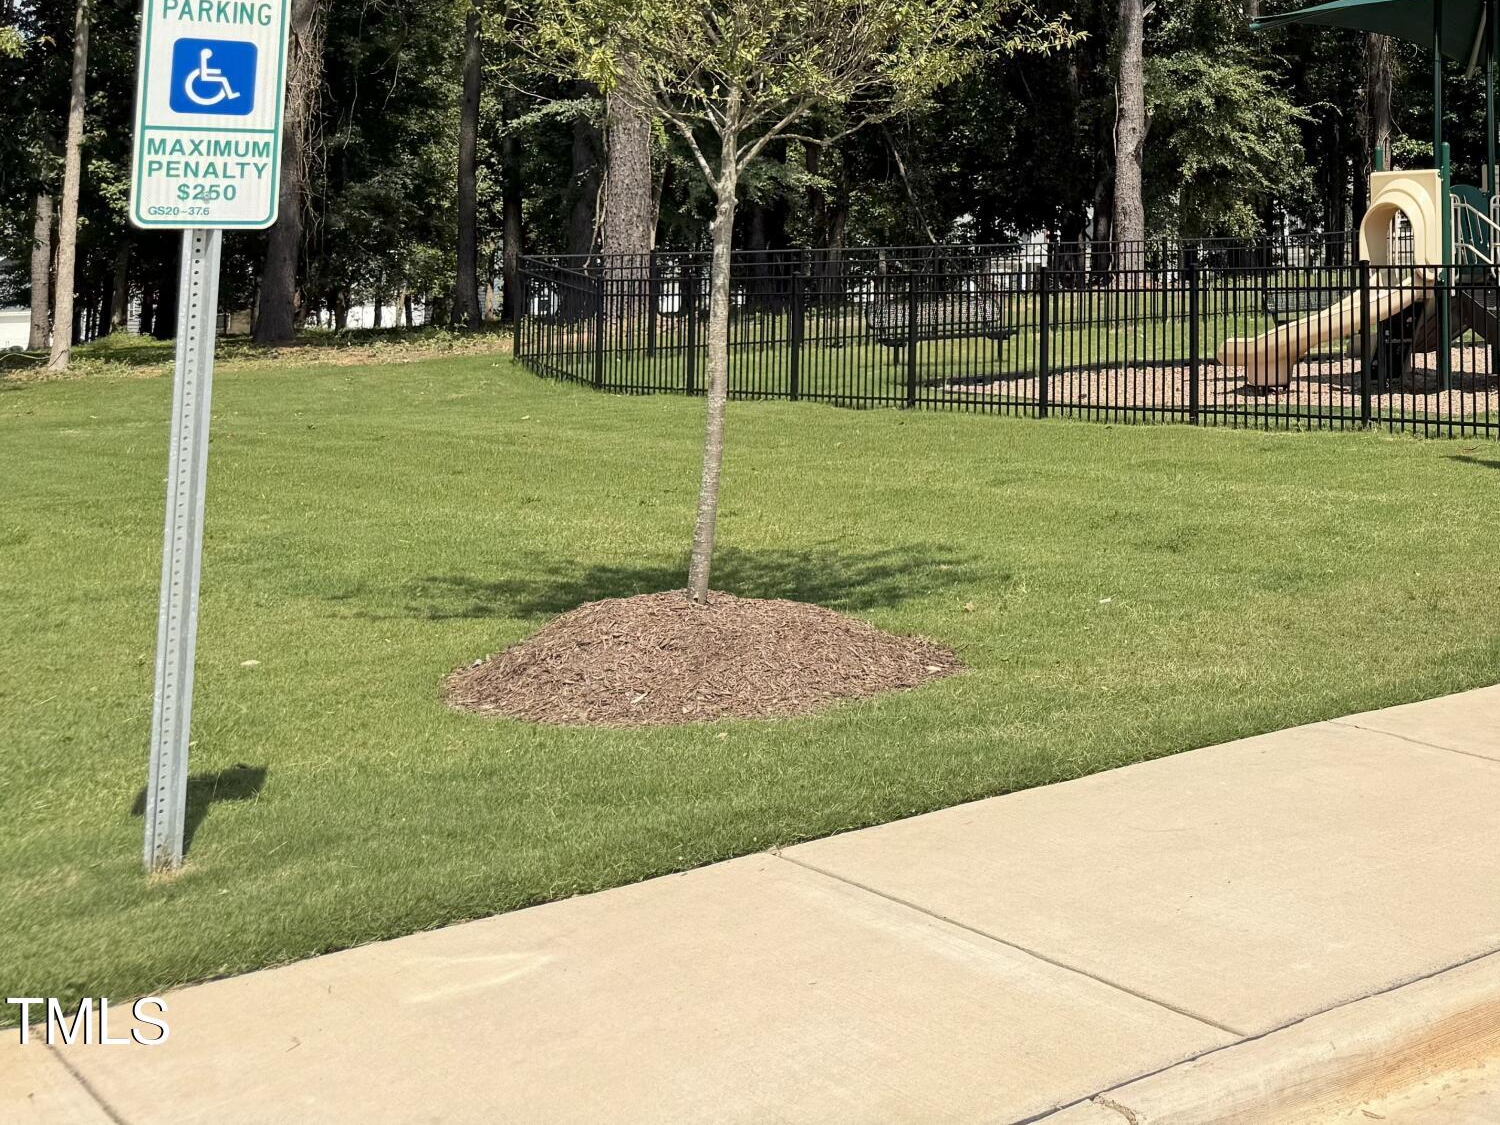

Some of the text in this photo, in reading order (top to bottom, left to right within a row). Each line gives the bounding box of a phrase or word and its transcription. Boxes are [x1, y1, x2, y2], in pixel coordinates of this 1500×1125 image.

[147, 138, 270, 159] MAXIMUM
[147, 160, 268, 180] PENALTY
[177, 183, 236, 202] $250
